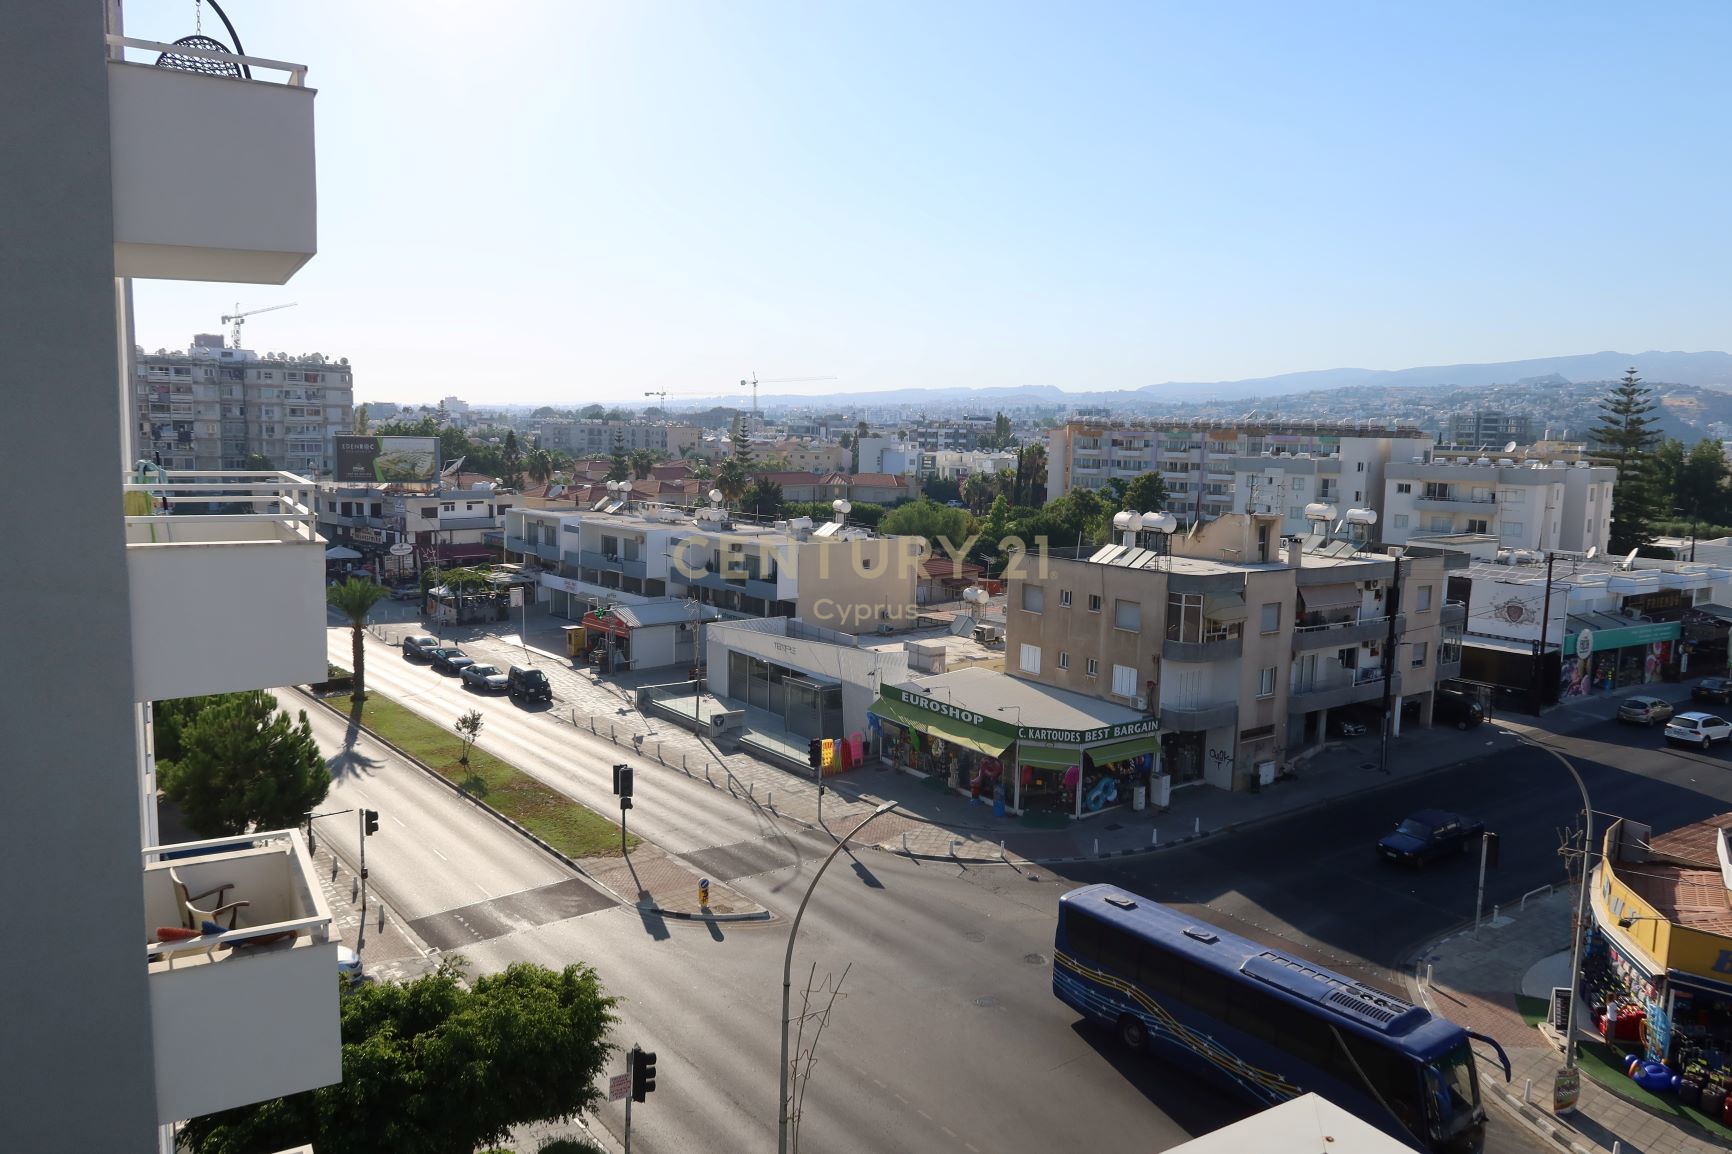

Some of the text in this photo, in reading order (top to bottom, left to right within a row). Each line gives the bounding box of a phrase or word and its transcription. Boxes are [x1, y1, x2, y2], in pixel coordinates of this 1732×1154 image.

[901, 691, 984, 725] EUROSHOP
[1018, 721, 1159, 742] C. KARTOUDES BEST BARGAIN
